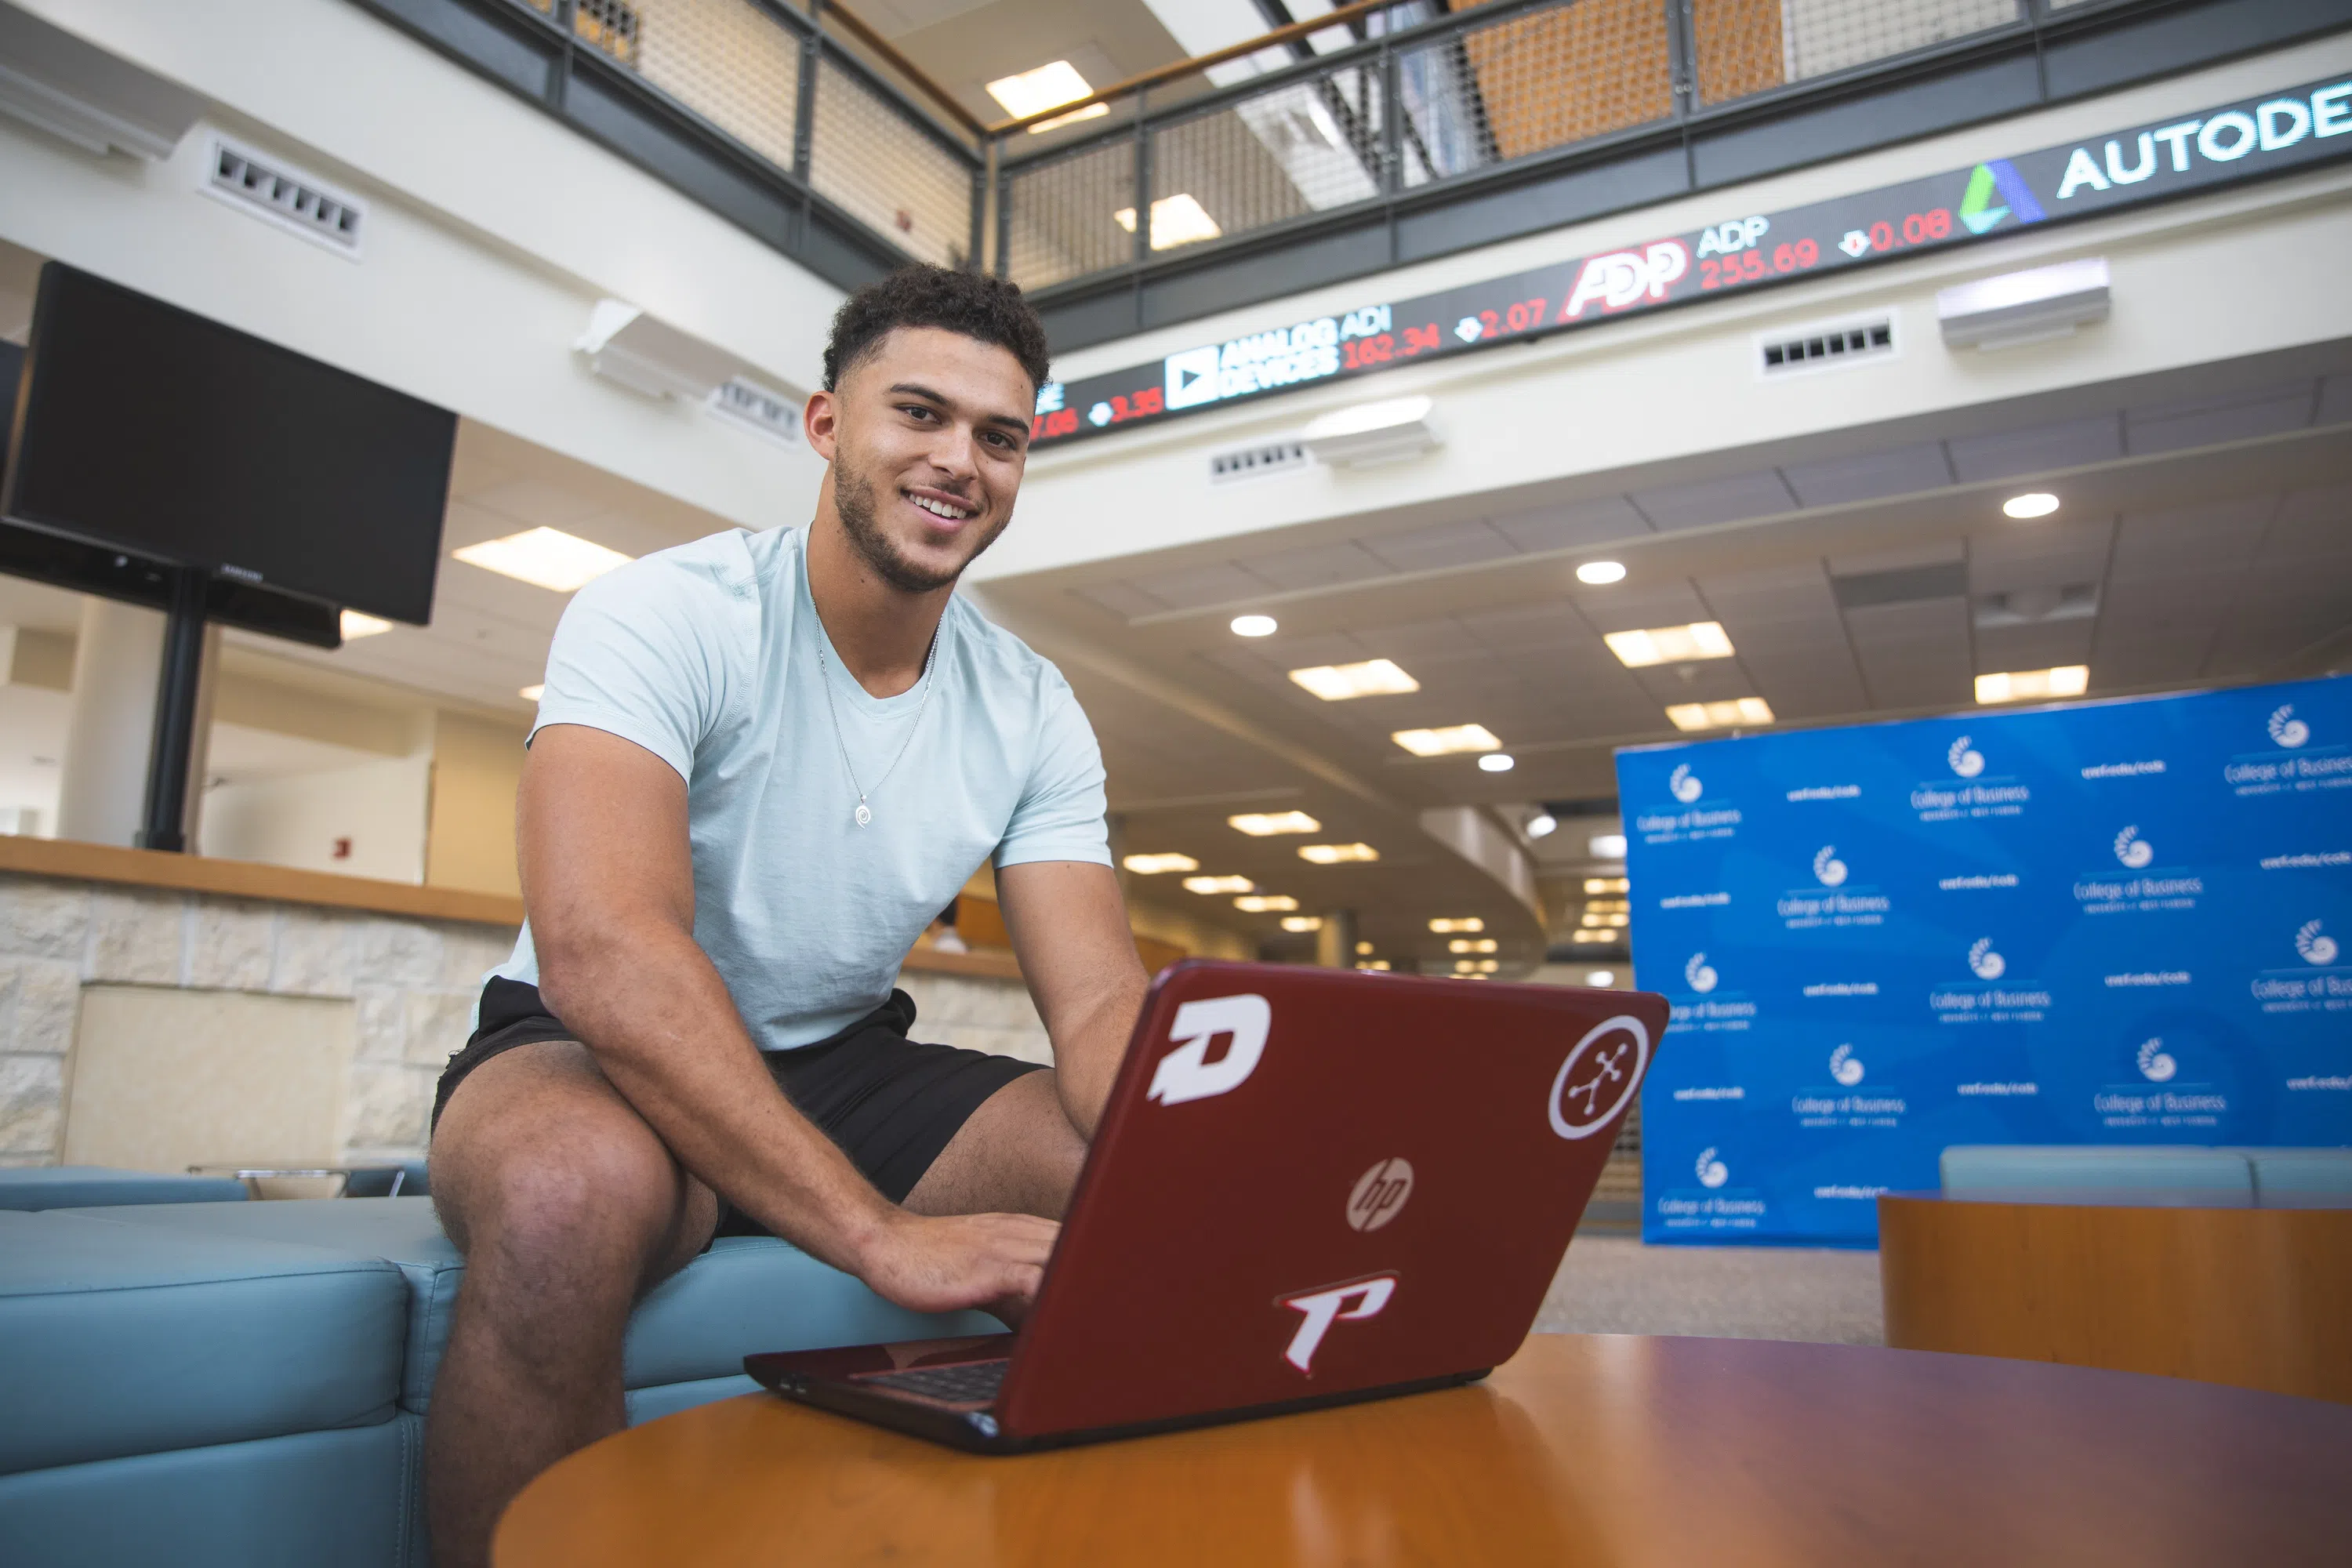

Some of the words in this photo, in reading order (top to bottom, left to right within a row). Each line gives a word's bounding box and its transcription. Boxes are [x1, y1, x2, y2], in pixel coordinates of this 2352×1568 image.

[2056, 79, 2352, 199] AUTODE
[1697, 215, 1770, 259] ADP
[1699, 238, 1820, 289] 255.69
[1869, 208, 1952, 252] 0.08
[1560, 238, 1689, 321] ADP
[1220, 317, 1338, 368] ANALOG
[1339, 303, 1392, 341] ADI
[1342, 322, 1441, 369] 162.34
[1479, 298, 1548, 339] 2.07
[1218, 345, 1340, 399] DEVICES
[1352, 1159, 1409, 1230] hp
